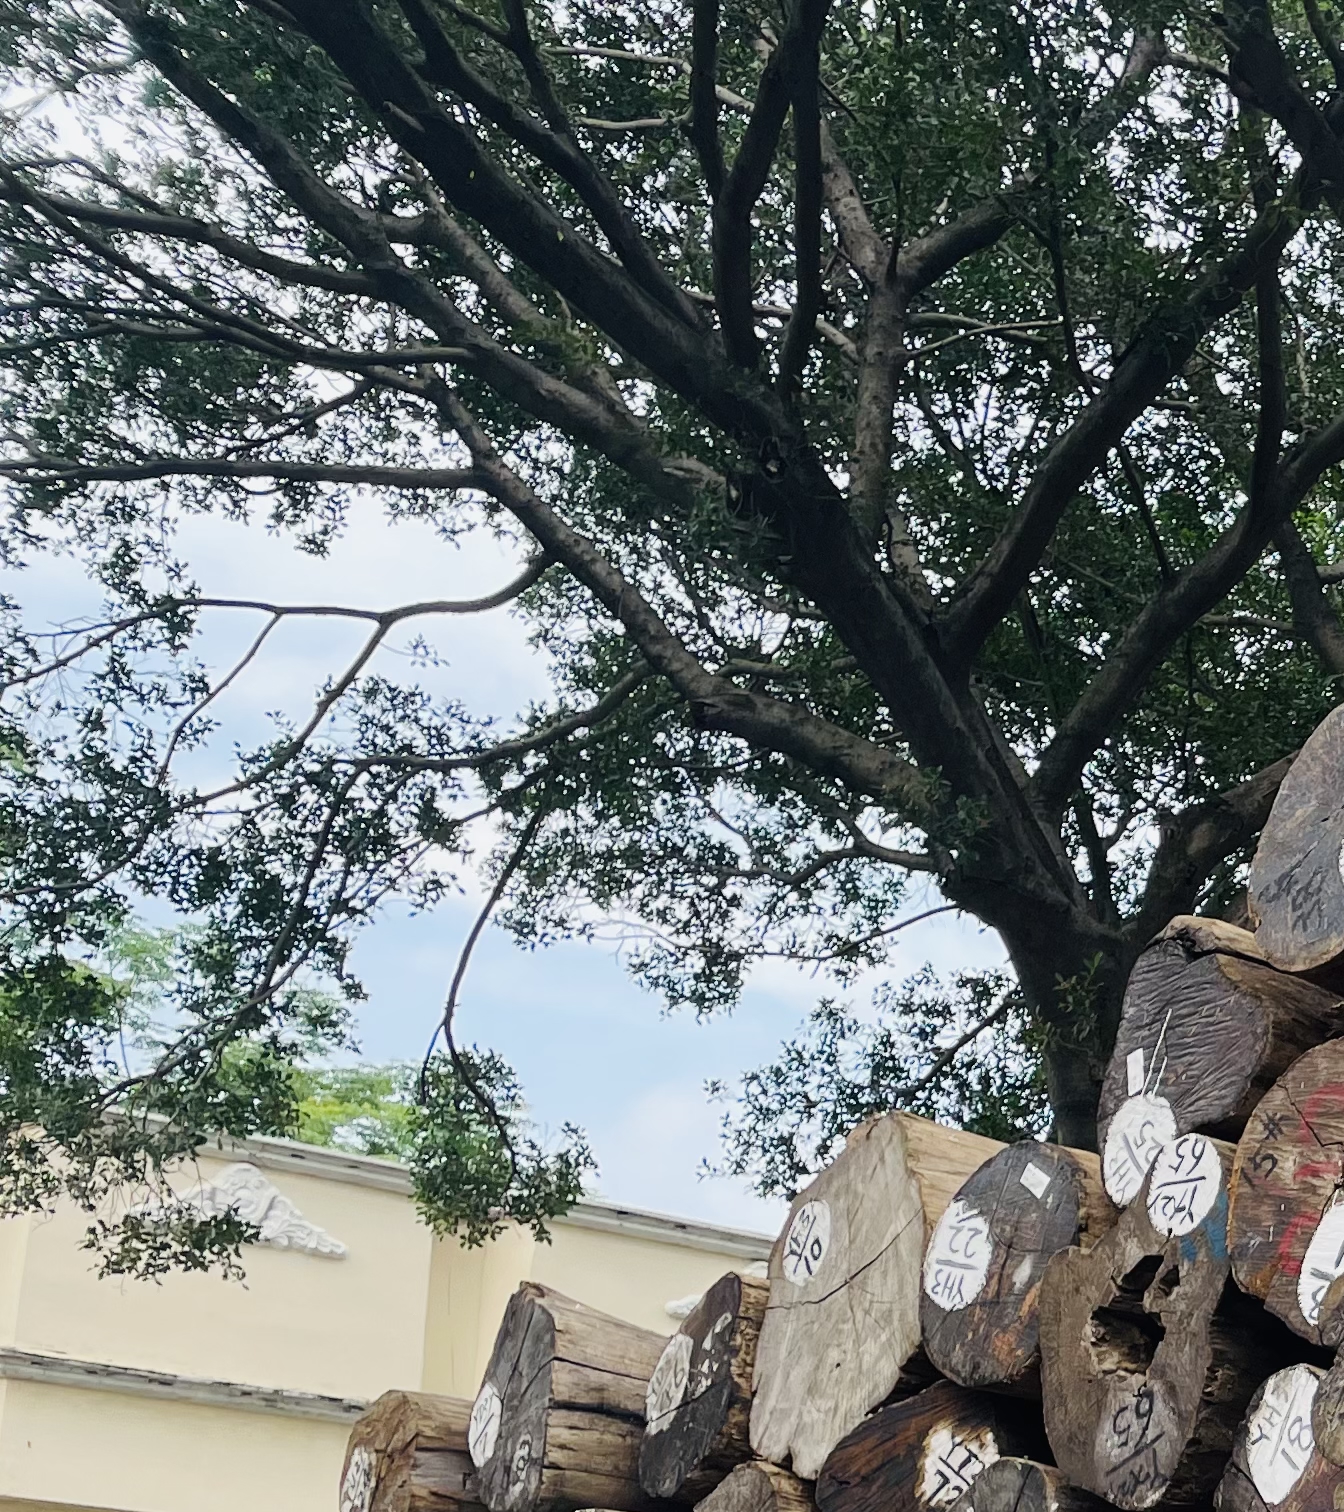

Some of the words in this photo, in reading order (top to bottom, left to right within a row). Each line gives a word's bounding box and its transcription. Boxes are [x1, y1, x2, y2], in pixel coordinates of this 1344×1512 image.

[803, 1237, 823, 1277] 10
[931, 1268, 965, 1302] YH3
[1280, 1418, 1314, 1471] 18
